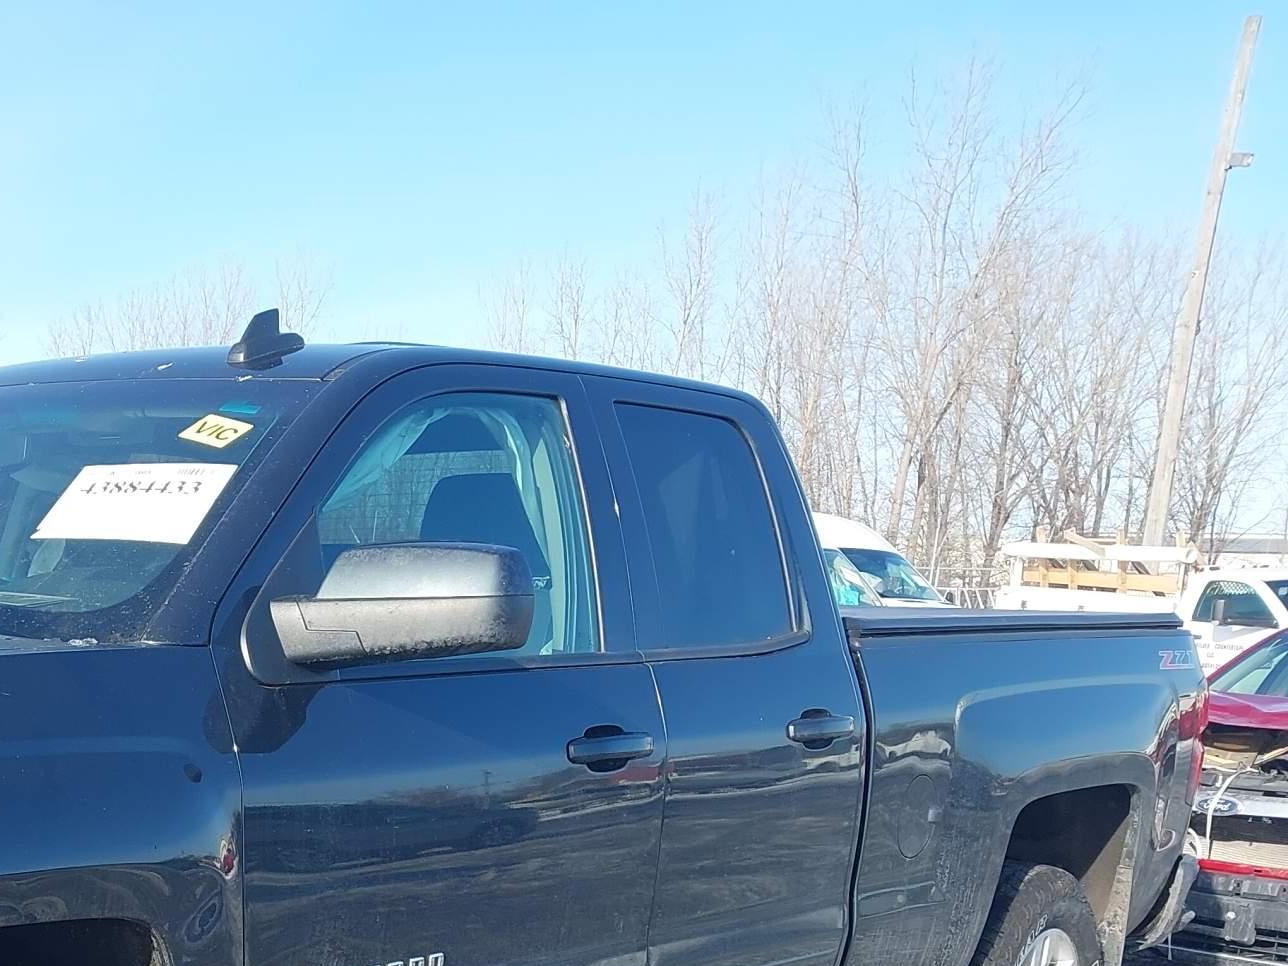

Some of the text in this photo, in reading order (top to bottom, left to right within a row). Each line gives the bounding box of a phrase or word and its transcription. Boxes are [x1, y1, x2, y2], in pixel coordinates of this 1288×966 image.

[196, 420, 239, 441] VIC
[80, 480, 203, 495] 43884433
[1158, 650, 1196, 670] Z71
[1199, 799, 1233, 812] Frd
